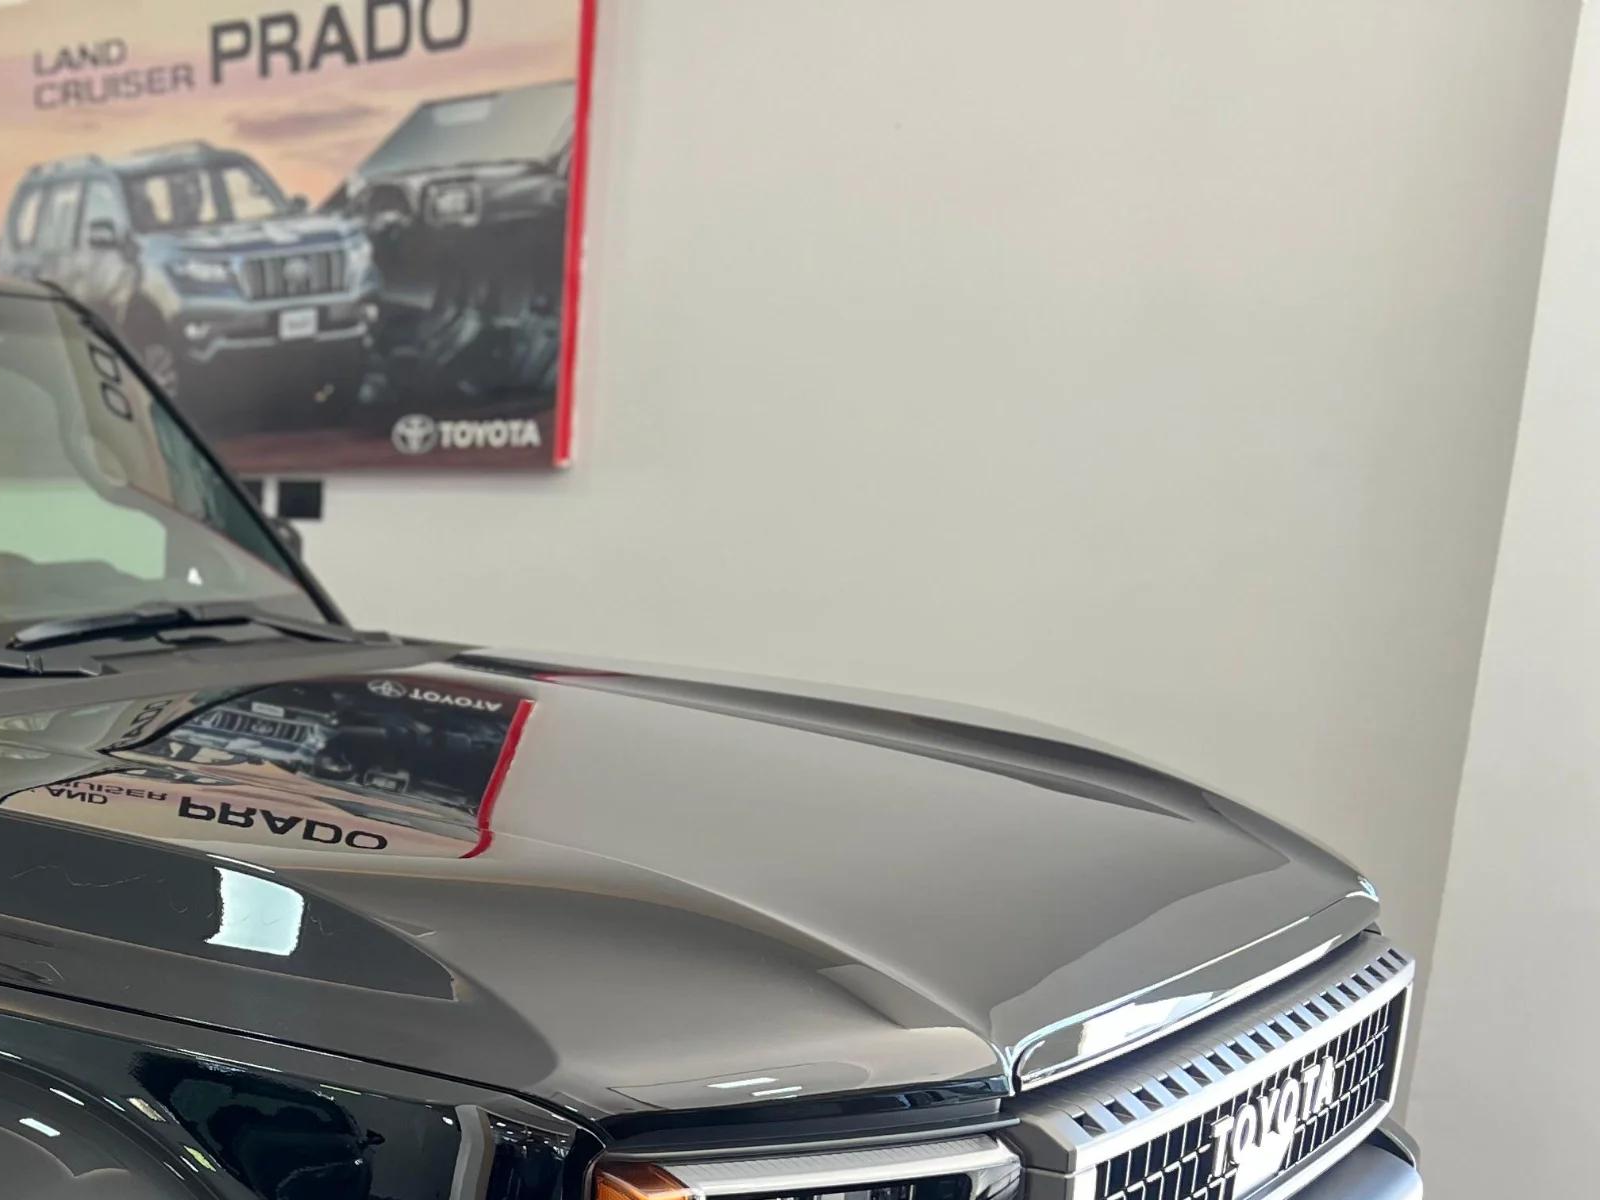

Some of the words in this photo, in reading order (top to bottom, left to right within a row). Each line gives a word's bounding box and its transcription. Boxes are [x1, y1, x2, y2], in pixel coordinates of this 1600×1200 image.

[33, 37, 127, 76] LAND
[211, 0, 471, 84] PRADO
[34, 62, 194, 110] CRUISER
[439, 419, 541, 450] TOYOTA
[1211, 1055, 1337, 1178] TOYOTA
